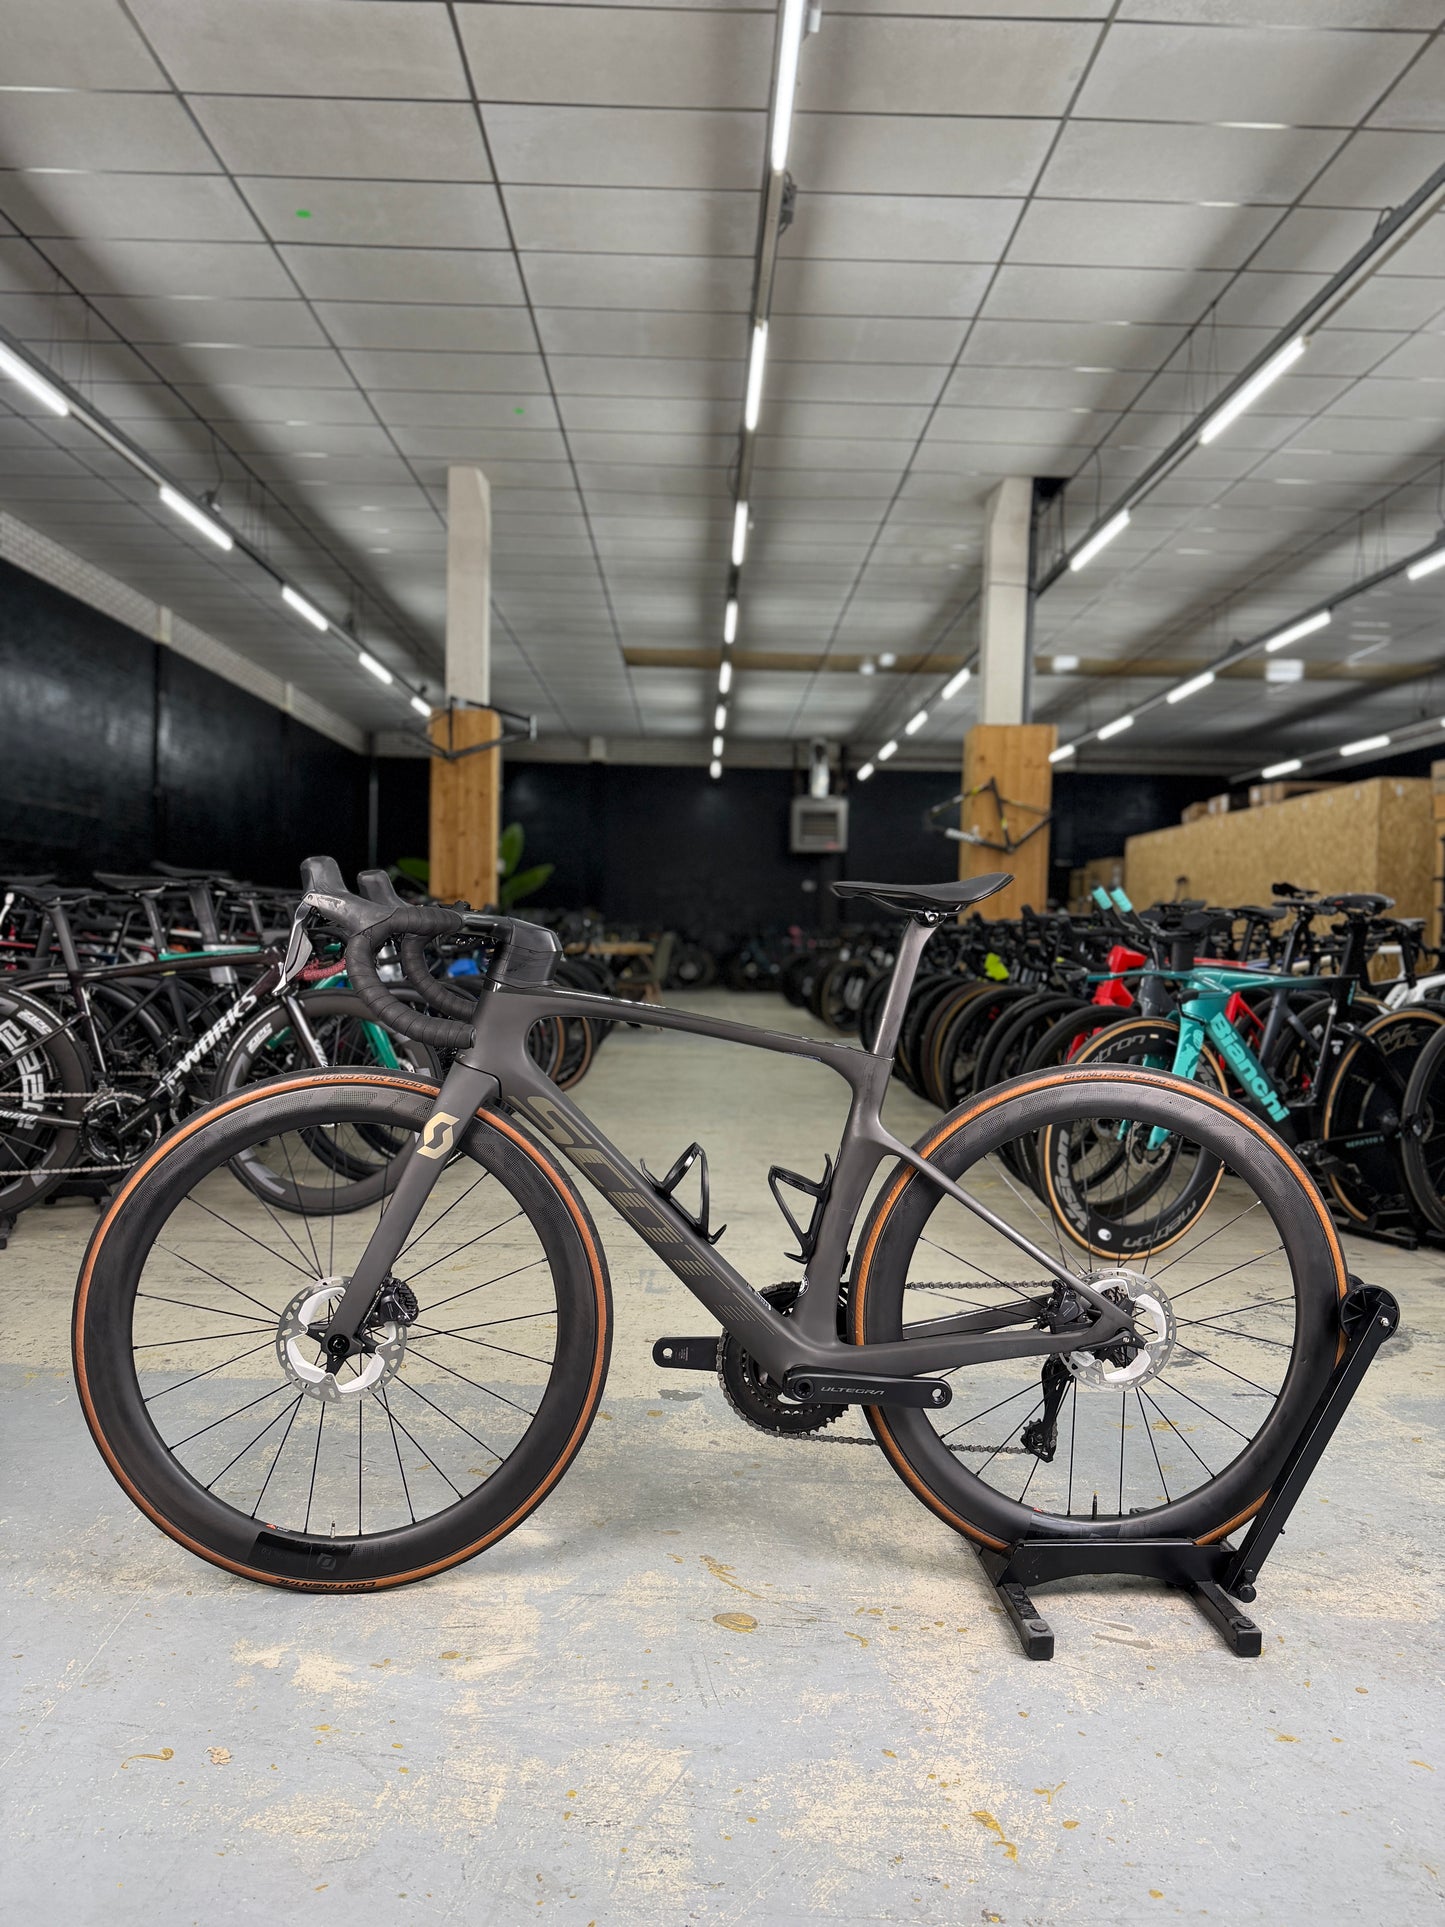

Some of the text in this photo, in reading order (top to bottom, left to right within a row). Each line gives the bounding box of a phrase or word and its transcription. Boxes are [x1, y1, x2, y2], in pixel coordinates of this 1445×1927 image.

[1207, 1012, 1291, 1123] Bianchi
[312, 1073, 354, 1082] GRAND
[355, 1074, 385, 1082] PRIX
[508, 1095, 778, 1336] SCOTT
[820, 1386, 886, 1396] ULTEGRA
[276, 1577, 377, 1590] CONTINENTAL
